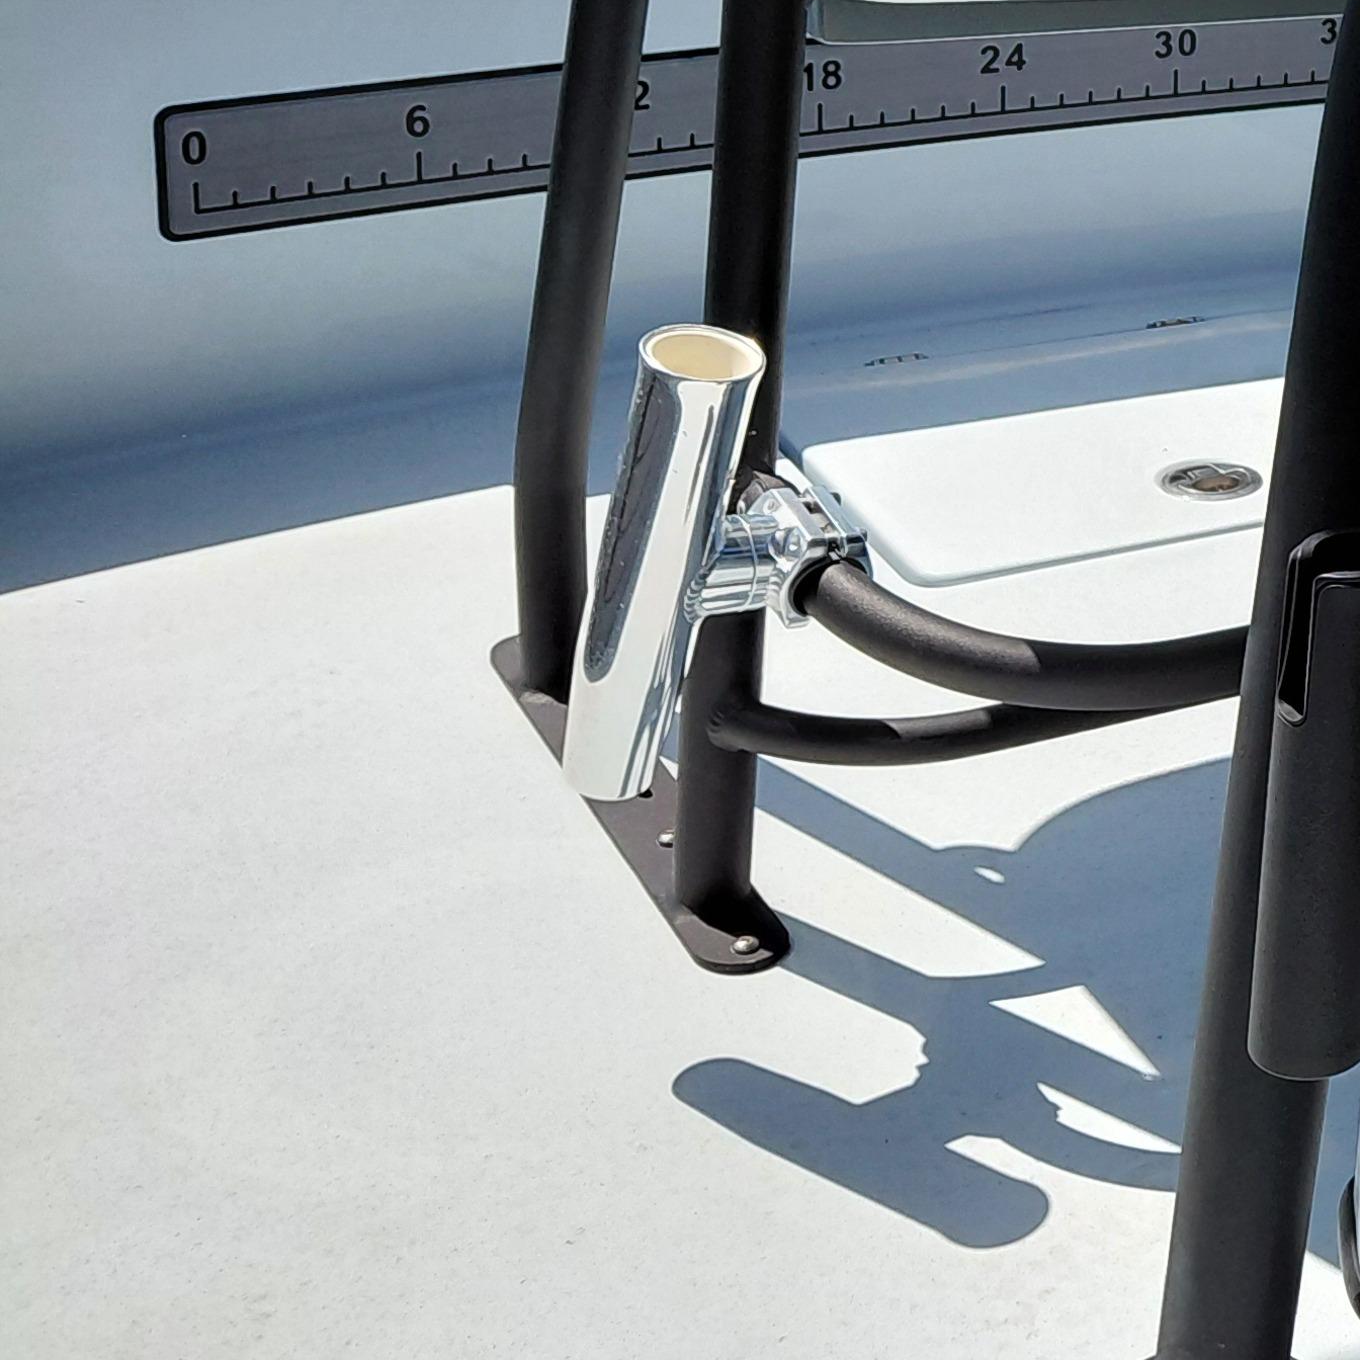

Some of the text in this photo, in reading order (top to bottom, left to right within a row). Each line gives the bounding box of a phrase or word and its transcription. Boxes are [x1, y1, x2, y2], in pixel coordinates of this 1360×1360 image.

[181, 131, 207, 165] 0
[405, 105, 430, 138] 6
[634, 81, 650, 111] 2
[803, 60, 842, 91] 18
[980, 43, 1027, 75] 24
[1154, 29, 1197, 59] 30
[1320, 18, 1338, 45] 3
